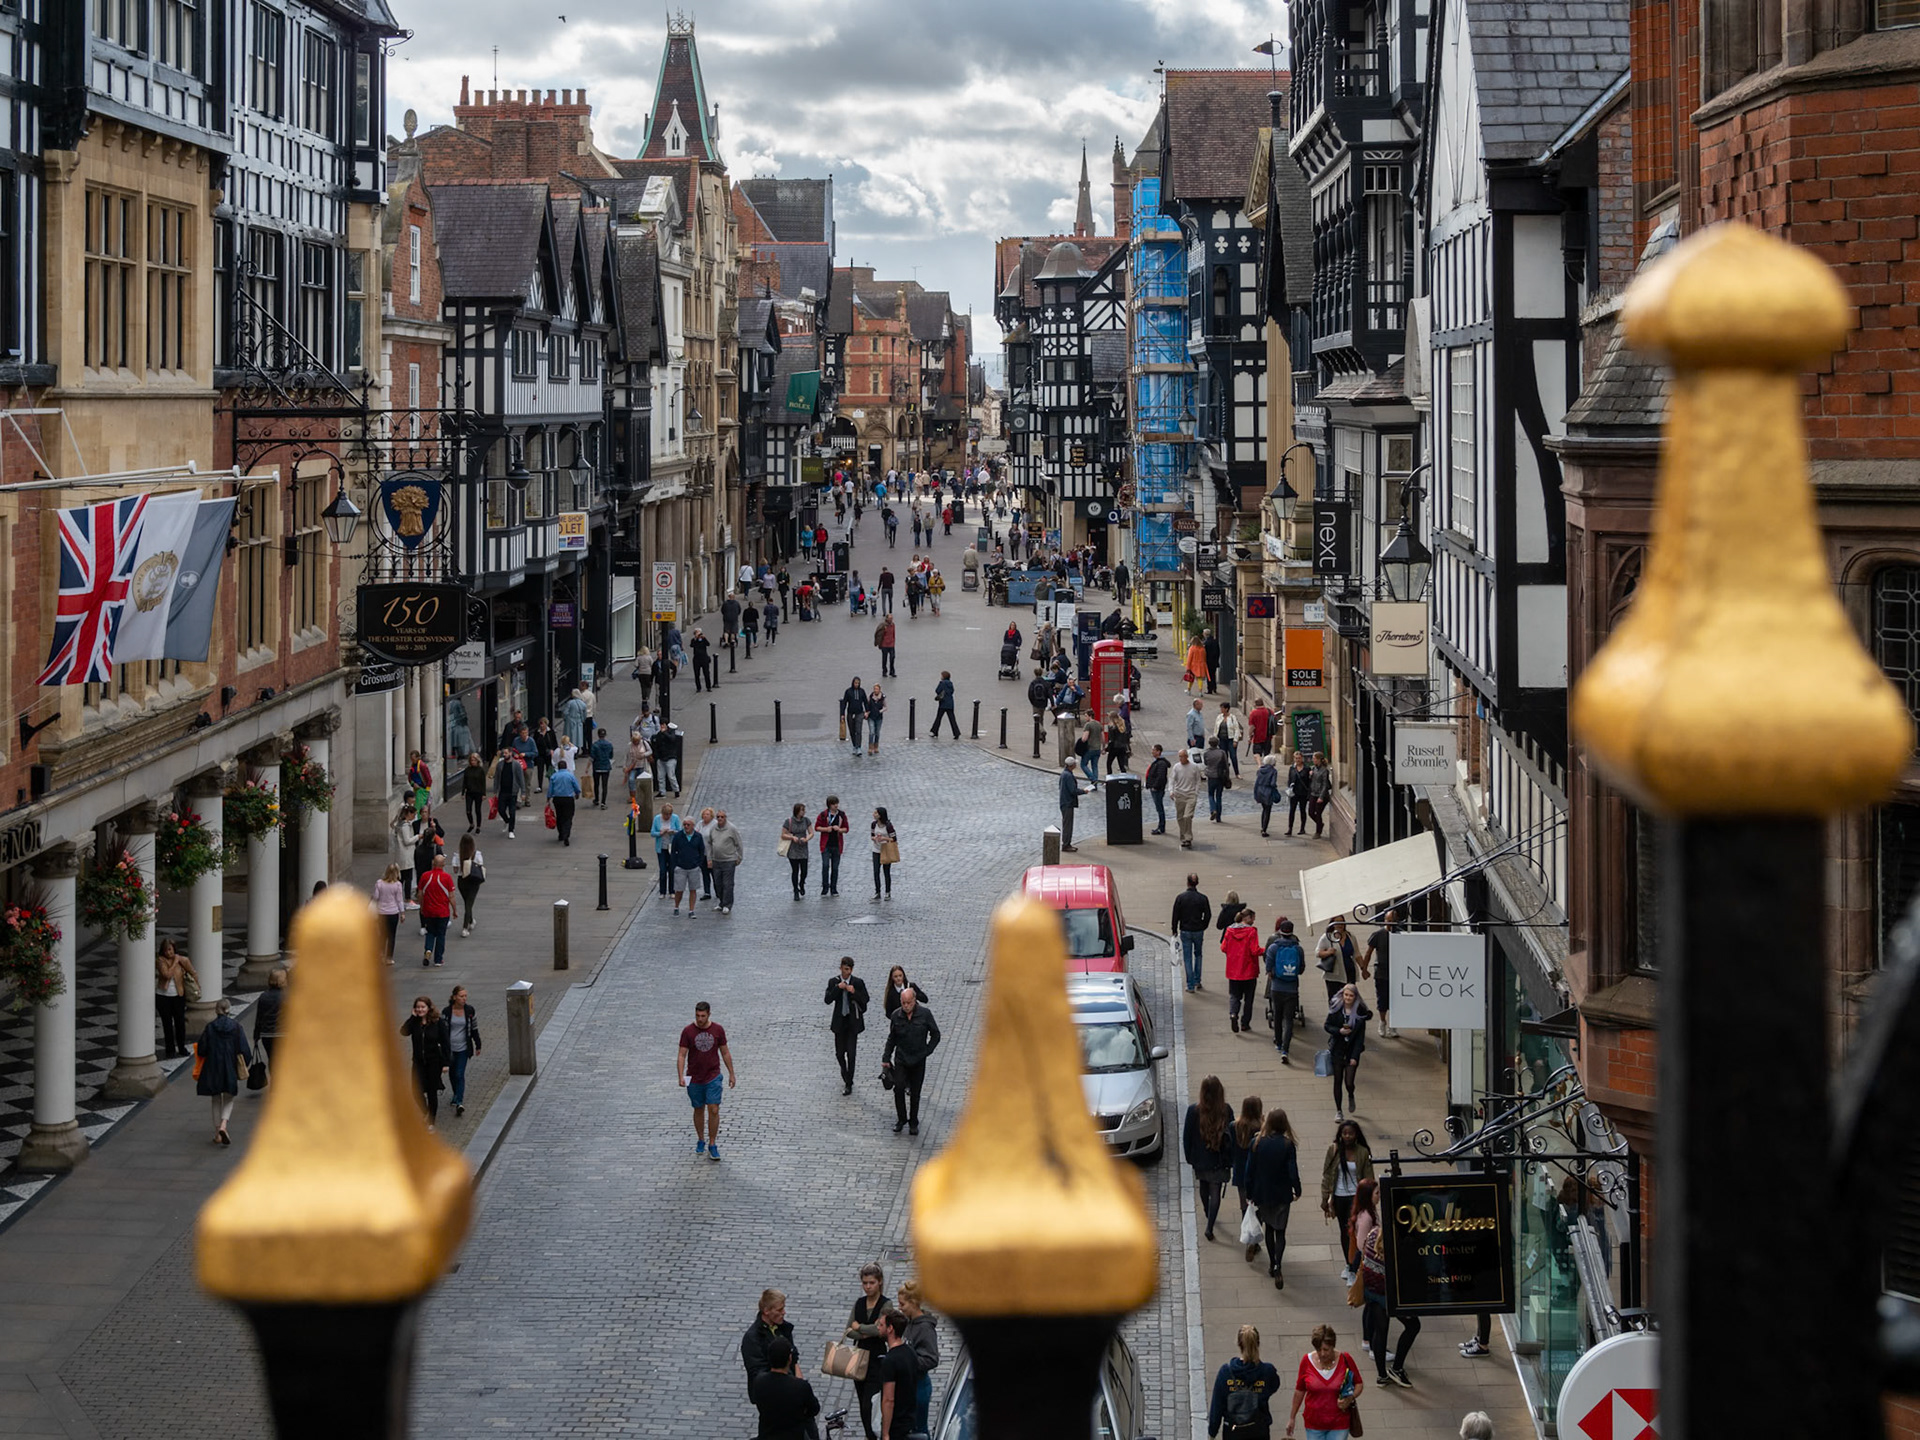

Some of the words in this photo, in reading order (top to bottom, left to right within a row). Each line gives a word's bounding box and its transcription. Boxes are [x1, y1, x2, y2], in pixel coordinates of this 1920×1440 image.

[788, 402, 811, 410] ROLEX
[568, 514, 584, 523] SHOP
[565, 522, 582, 534] LET
[1319, 511, 1337, 568] next
[383, 592, 440, 627] 150
[1375, 630, 1422, 644] Thorntons
[360, 672, 396, 687] Grosvenor
[1292, 670, 1317, 679] SOLE
[1407, 745, 1444, 756] Russell
[1401, 756, 1449, 769] Bromley
[1406, 965, 1469, 980] NEW
[1401, 982, 1475, 998] LOOK
[1396, 1202, 1496, 1233] Waltons
[1417, 1244, 1431, 1256] of
[1432, 1244, 1477, 1255] Chester
[1427, 1275, 1450, 1284] Since
